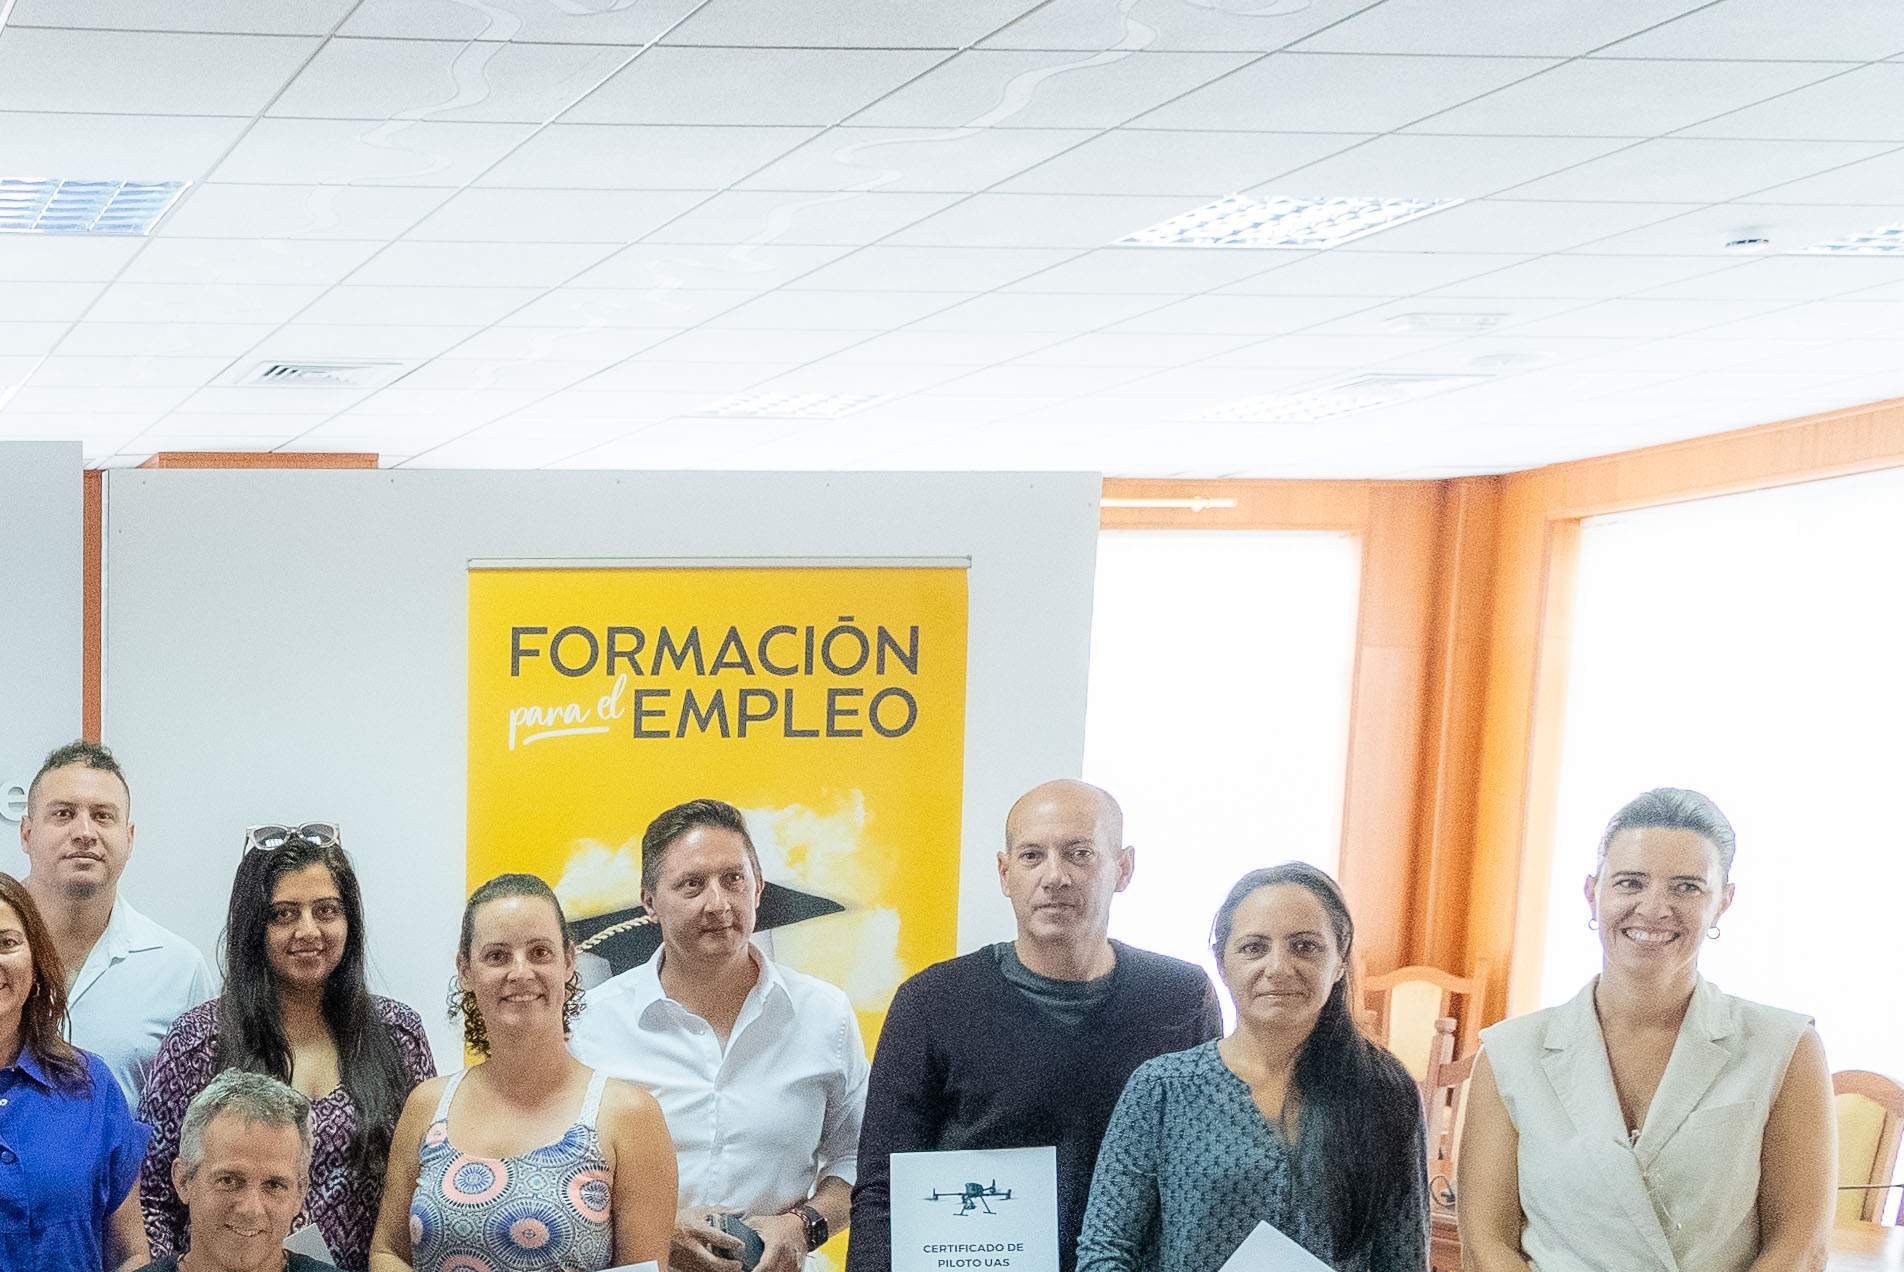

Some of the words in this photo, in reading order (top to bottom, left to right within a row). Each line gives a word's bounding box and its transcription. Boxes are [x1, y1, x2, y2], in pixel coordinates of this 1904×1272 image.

[510, 614, 920, 677] FORMACIÓN
[508, 702, 587, 751] para
[596, 674, 627, 722] el
[632, 686, 919, 739] EMPLEO
[923, 1243, 1005, 1254] CERTIFICADO
[1007, 1242, 1024, 1252] DE
[937, 1258, 982, 1268] PILOTO
[984, 1258, 1010, 1267] UAS
